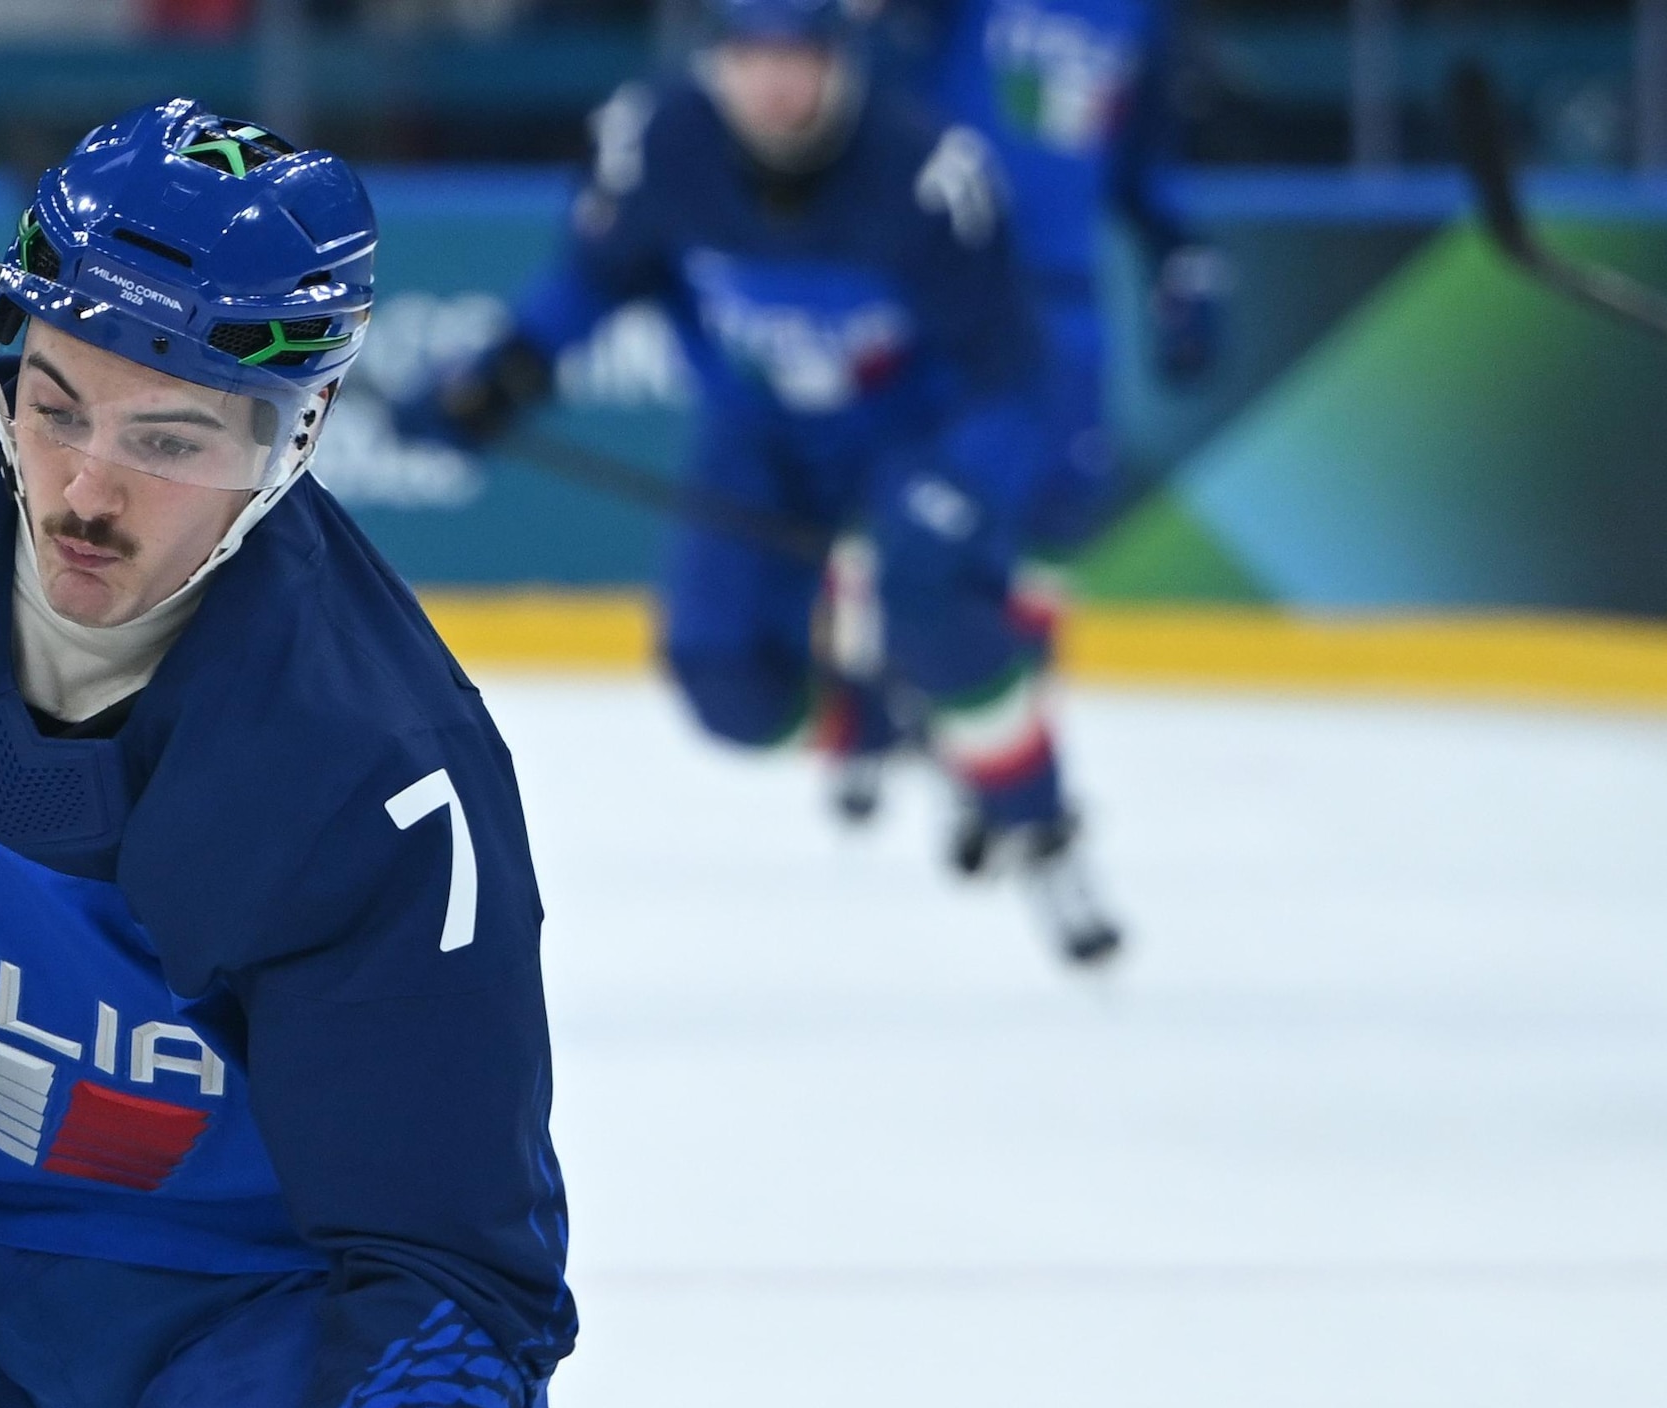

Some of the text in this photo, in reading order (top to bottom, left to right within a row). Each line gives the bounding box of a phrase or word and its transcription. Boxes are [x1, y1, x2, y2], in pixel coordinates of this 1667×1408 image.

[87, 265, 183, 312] MILANO CORTINA
[119, 289, 144, 306] 2026
[383, 767, 479, 953] 7
